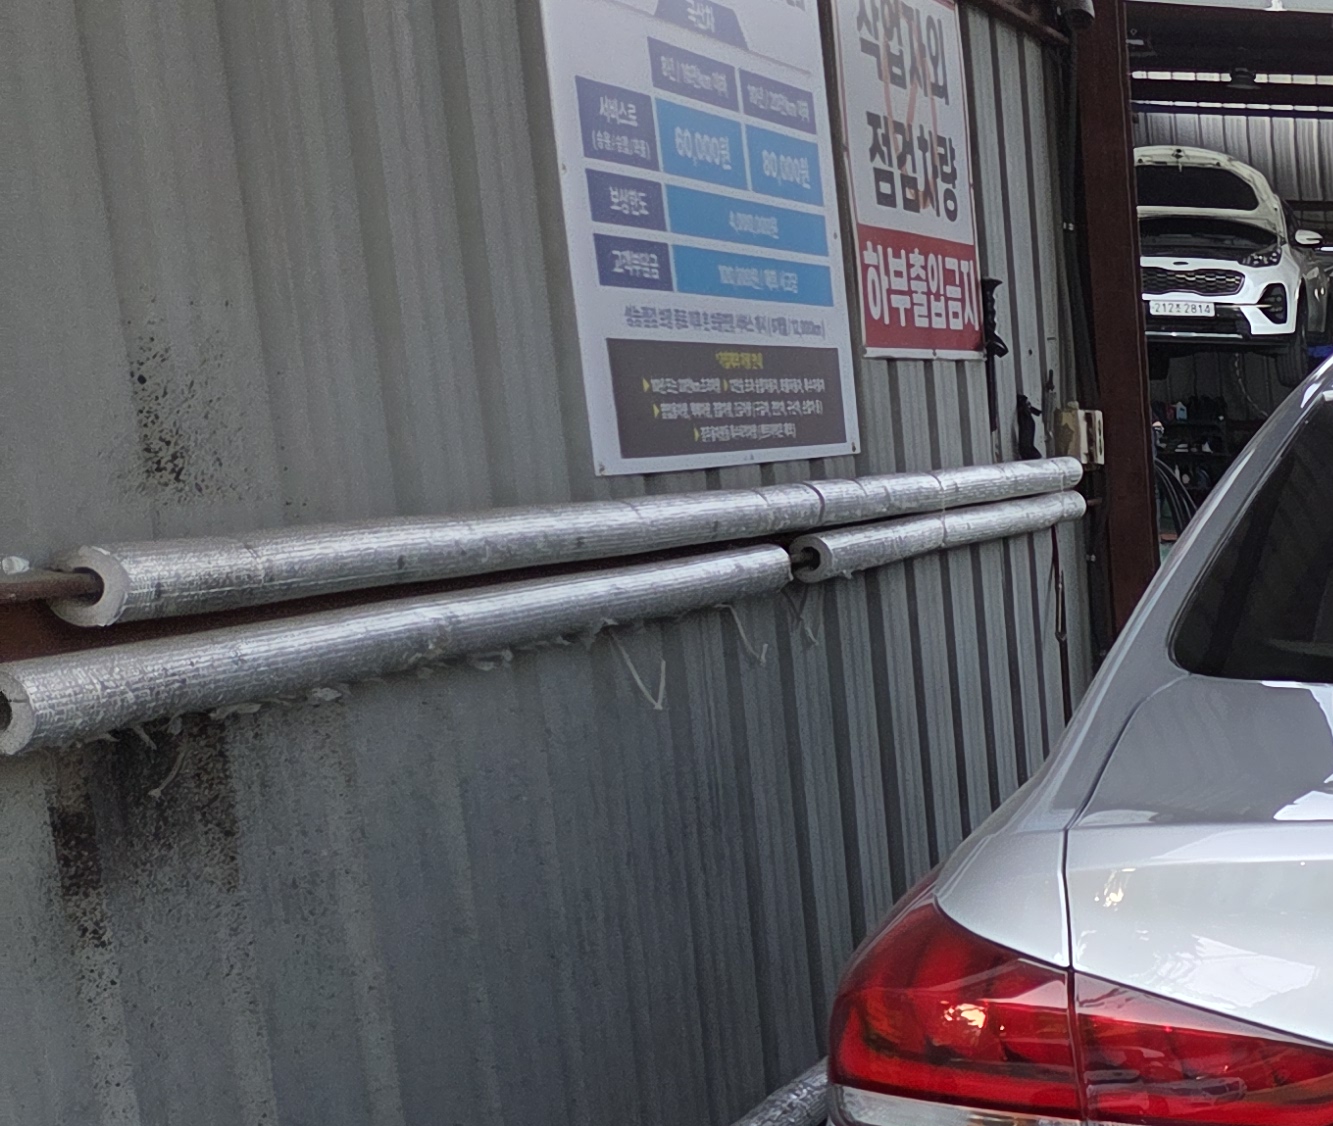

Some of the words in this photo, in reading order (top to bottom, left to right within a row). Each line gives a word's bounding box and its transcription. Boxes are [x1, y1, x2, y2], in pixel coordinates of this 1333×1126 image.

[674, 126, 732, 170] 60,000원
[762, 150, 811, 189] 80,000원
[866, 111, 958, 222] 점검차량
[863, 241, 979, 331] 하부출입금지
